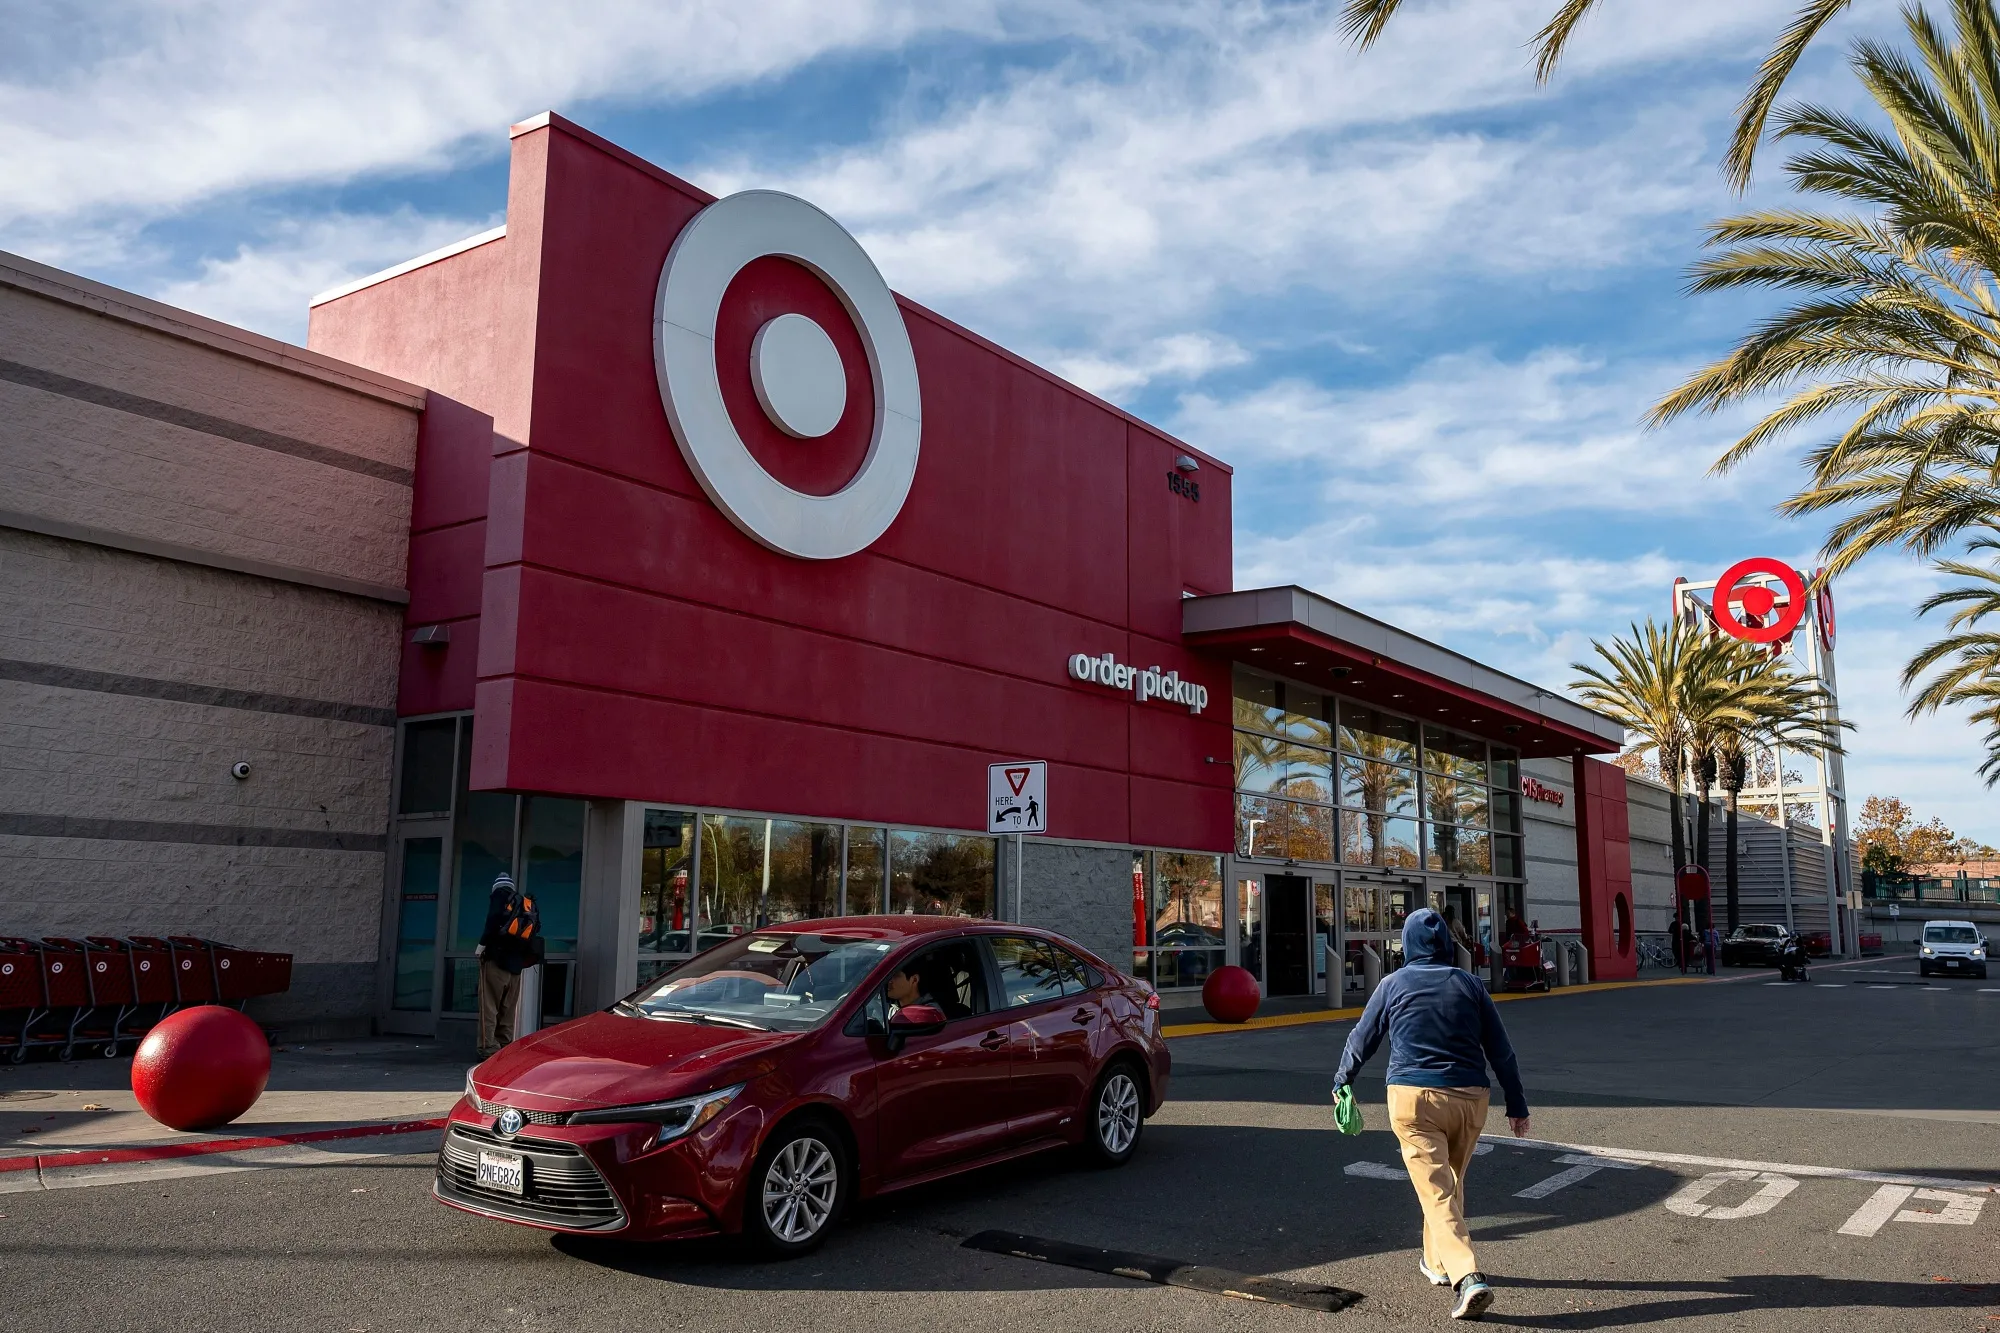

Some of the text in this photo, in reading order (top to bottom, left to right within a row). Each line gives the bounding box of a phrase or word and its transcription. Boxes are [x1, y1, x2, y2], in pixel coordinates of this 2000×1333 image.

[1167, 471, 1200, 503] 1555
[1068, 652, 1208, 714] order pickup
[995, 796, 1014, 806] HERE
[1012, 816, 1022, 825] TO
[481, 1163, 521, 1187] 9NEG826
